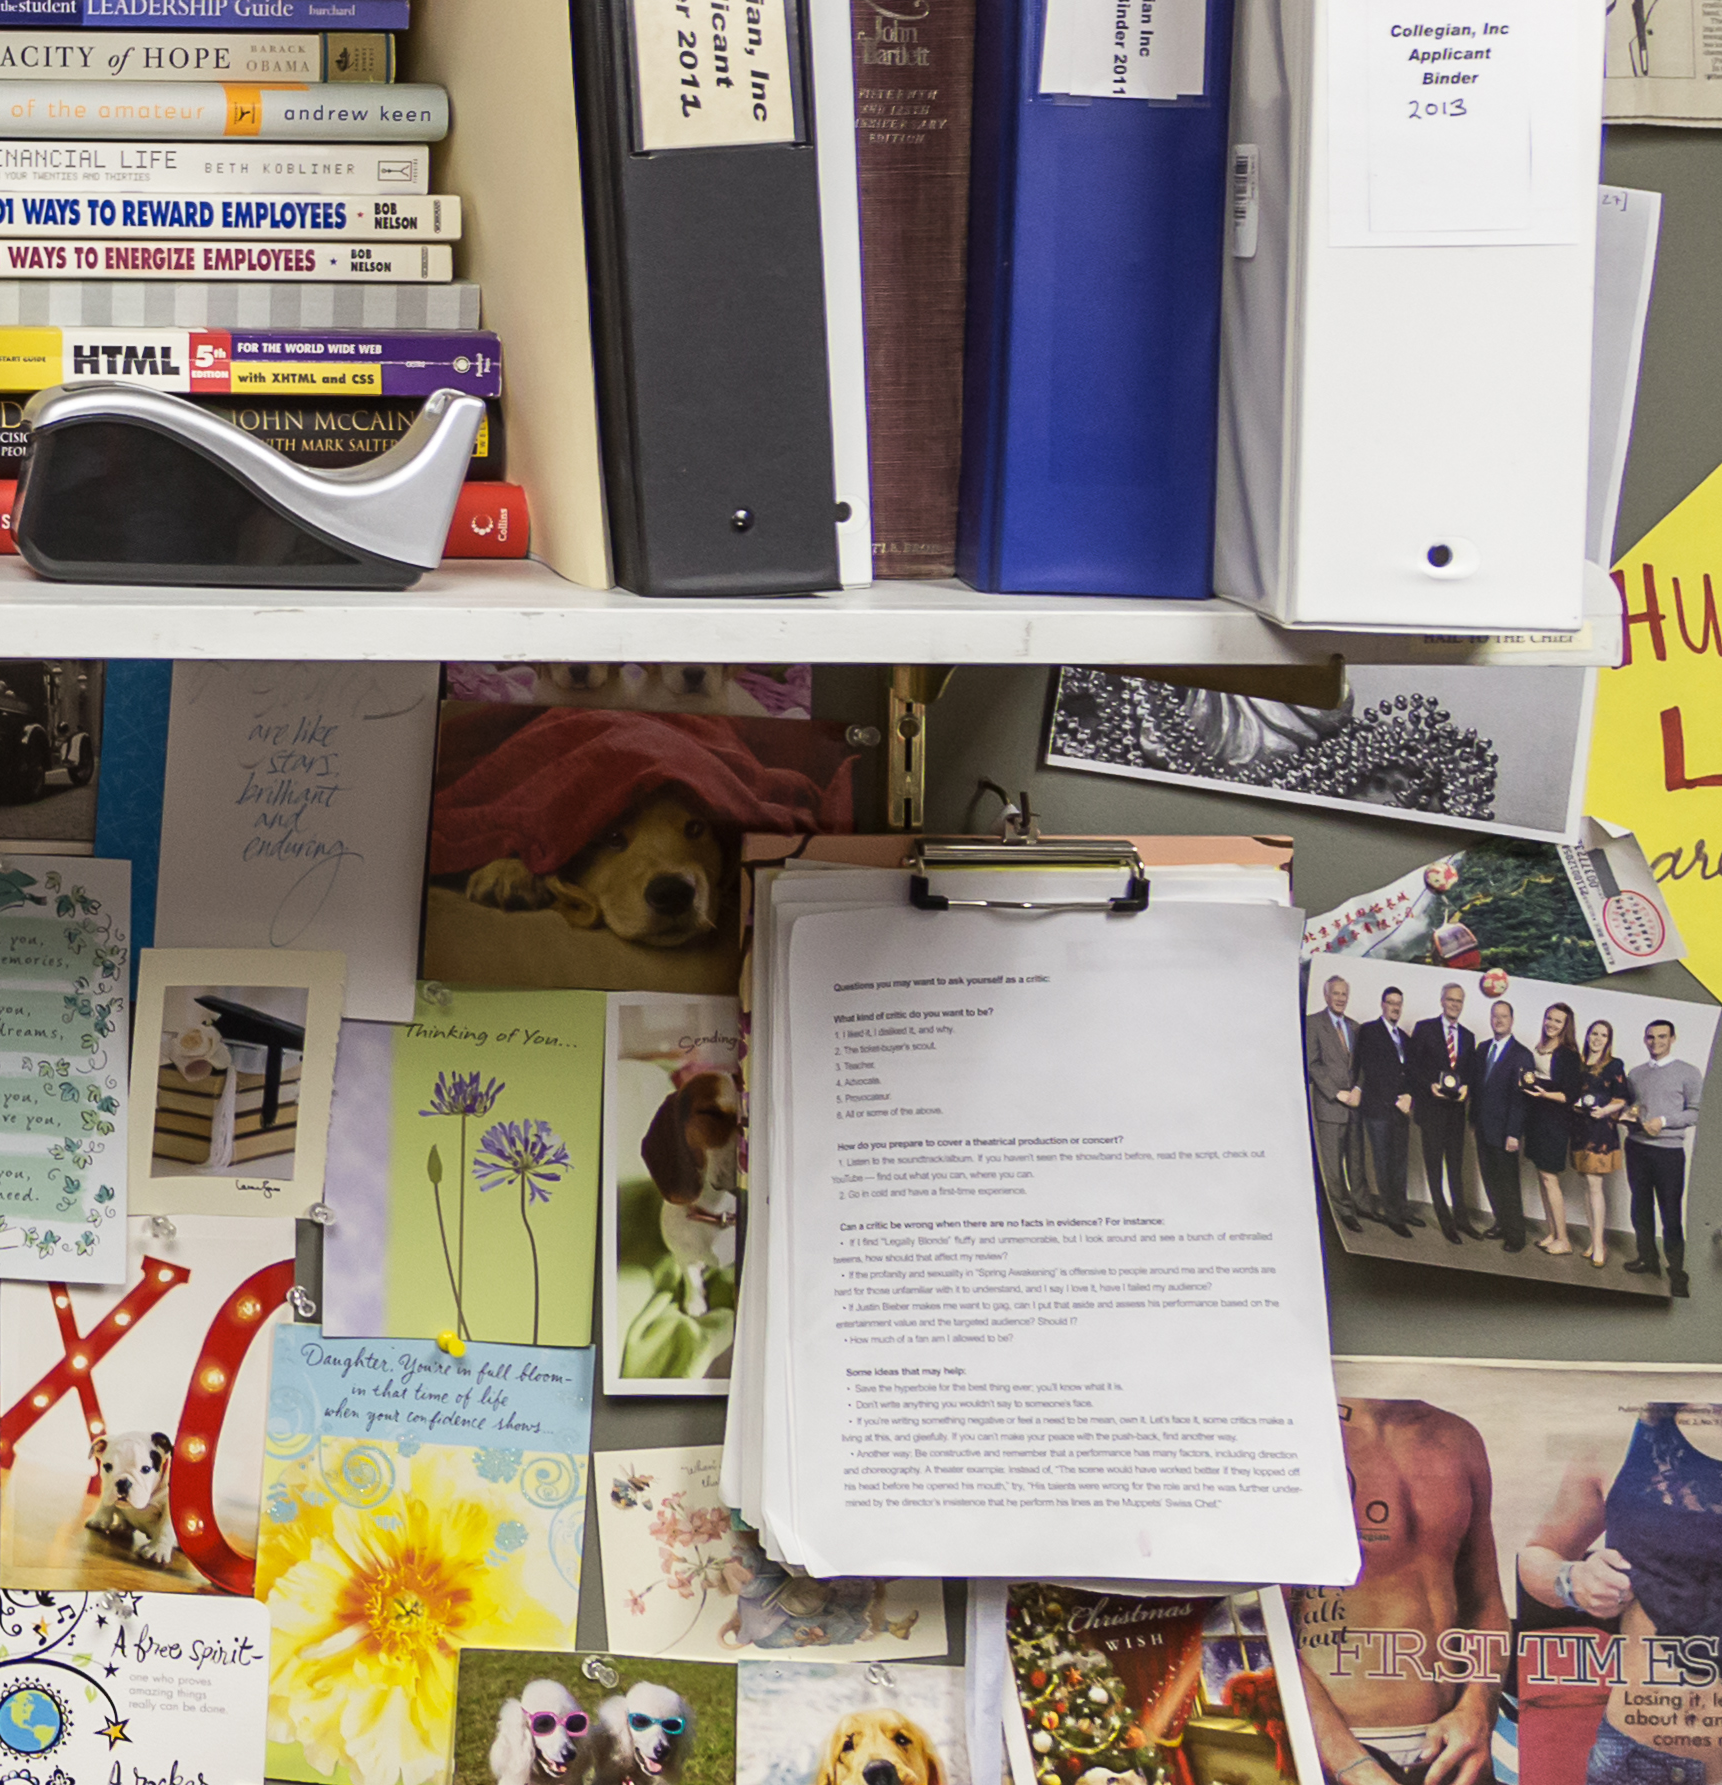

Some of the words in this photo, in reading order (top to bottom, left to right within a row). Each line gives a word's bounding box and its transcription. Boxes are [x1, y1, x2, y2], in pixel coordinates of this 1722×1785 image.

[0, 1, 19, 13] the
[1390, 24, 1477, 41] Collegian,
[1483, 22, 1510, 37] Inc
[250, 45, 306, 53] BARACK
[1139, 31, 1154, 57] Inc
[108, 47, 135, 75] of
[143, 47, 231, 69] HOPE
[1408, 46, 1491, 64] Applicant
[246, 60, 310, 73] OBAMA
[677, 29, 702, 118] 2011
[1112, 55, 1128, 94] 2011
[1422, 70, 1479, 87] Binder
[750, 69, 770, 123] Inc
[11, 99, 36, 118] of
[48, 101, 87, 118] the
[98, 104, 205, 119] amateur
[284, 105, 368, 121] andrew
[381, 106, 432, 122] keen
[1408, 98, 1468, 120] 2013
[121, 151, 177, 168] LIFE
[205, 162, 249, 174] BETH
[263, 163, 356, 174] KOBLINER
[22, 198, 80, 226] WAYS
[88, 200, 116, 226] TO
[123, 200, 214, 228] REWARD
[222, 201, 346, 230] EMPLOYEES
[374, 202, 397, 215] BOB
[374, 216, 418, 229] NELSON
[8, 247, 66, 269] WAYS
[74, 247, 98, 269] TO
[105, 248, 195, 270] ENERGIZE
[203, 248, 316, 272] EMPLOYEES
[351, 249, 372, 260] BOB
[351, 262, 391, 272] NELSON
[195, 344, 227, 368] 5th
[237, 343, 259, 354] FOR
[262, 343, 282, 354] THE
[285, 344, 324, 354] WORLD
[328, 344, 355, 354] WIDE
[359, 344, 382, 354] WEB
[73, 345, 180, 376] HTML
[238, 373, 266, 384] with
[272, 373, 316, 384] XHTML
[322, 374, 346, 384] and
[352, 374, 374, 385] CSS
[405, 1022, 487, 1046] Thinking
[495, 1025, 515, 1045] of
[110, 1624, 129, 1657] A
[134, 1622, 184, 1663] free
[1330, 1628, 1509, 1683] FIRST
[1517, 1634, 1720, 1688] TIMES
